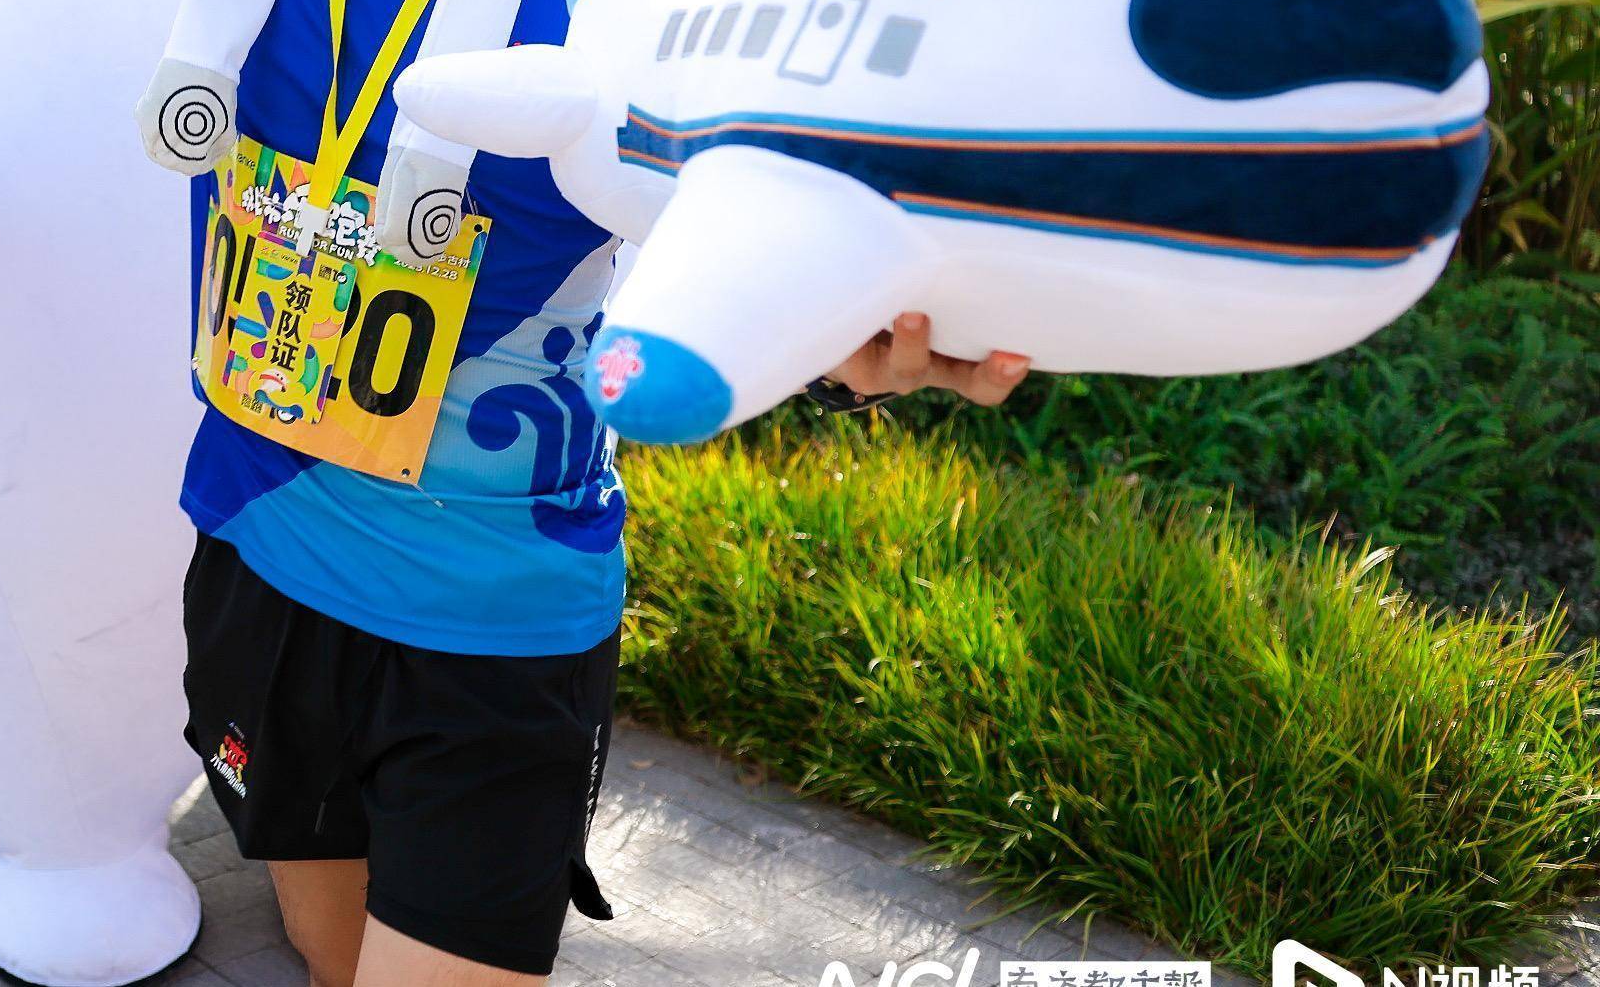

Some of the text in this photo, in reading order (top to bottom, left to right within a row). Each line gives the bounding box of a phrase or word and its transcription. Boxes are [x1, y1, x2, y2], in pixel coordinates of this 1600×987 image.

[329, 245, 355, 261] FUN
[208, 213, 436, 417] 00
[270, 280, 314, 372] 领队证
